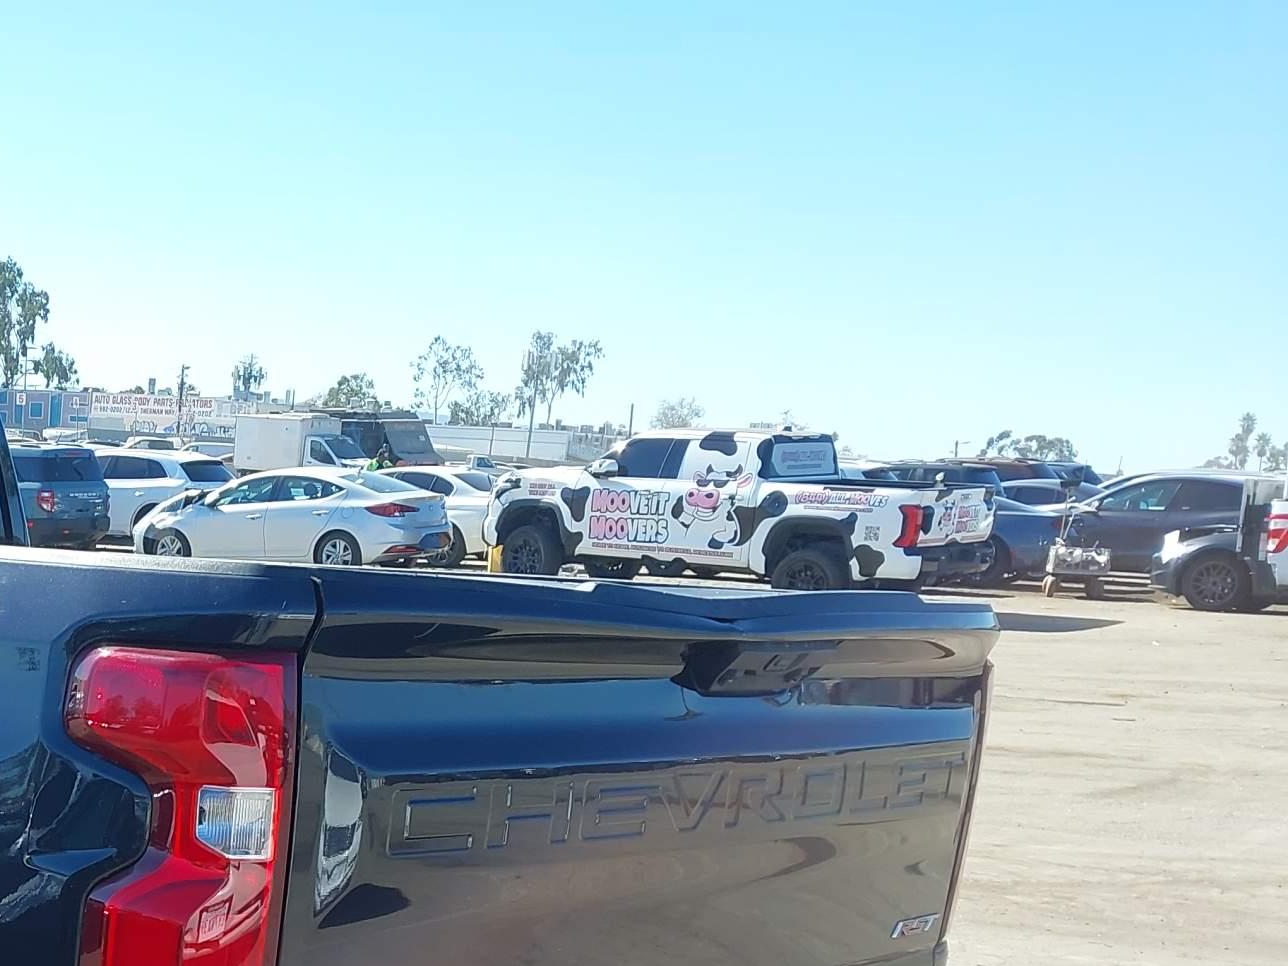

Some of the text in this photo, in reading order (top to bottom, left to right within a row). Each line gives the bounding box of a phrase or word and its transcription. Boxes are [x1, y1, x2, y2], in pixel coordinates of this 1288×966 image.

[94, 395, 110, 405] AUTO
[112, 396, 132, 405] GLASS
[588, 515, 669, 544] MOOVERS
[387, 752, 964, 857] CHEVROLET
[890, 912, 941, 939] RST
